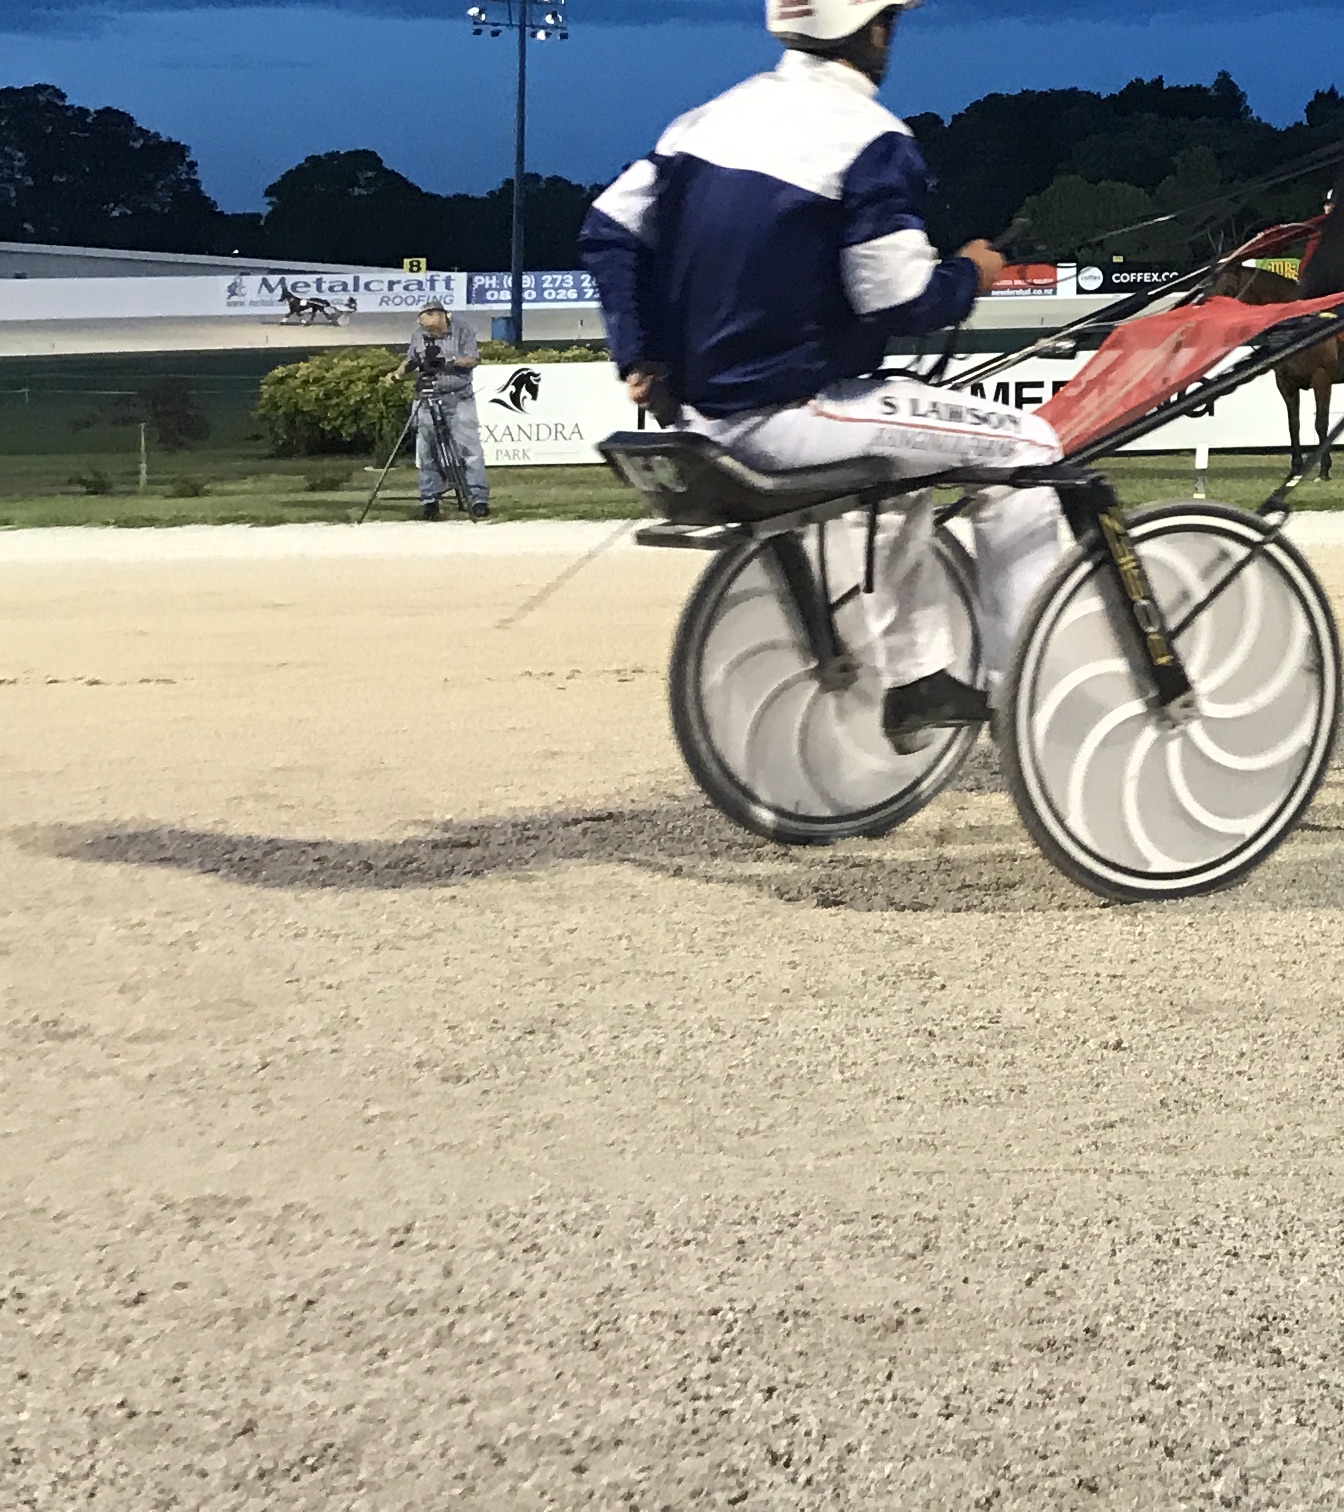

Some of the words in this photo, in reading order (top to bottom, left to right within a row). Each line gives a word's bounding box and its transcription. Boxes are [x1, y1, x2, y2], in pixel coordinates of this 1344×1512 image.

[408, 259, 423, 272] 8
[257, 275, 456, 295] Metalcraft
[542, 275, 573, 288] 273
[379, 295, 455, 306] ROOFING
[543, 289, 577, 299] 026
[880, 395, 898, 416] S
[479, 422, 585, 443] XANDRA
[495, 448, 532, 461] PARK
